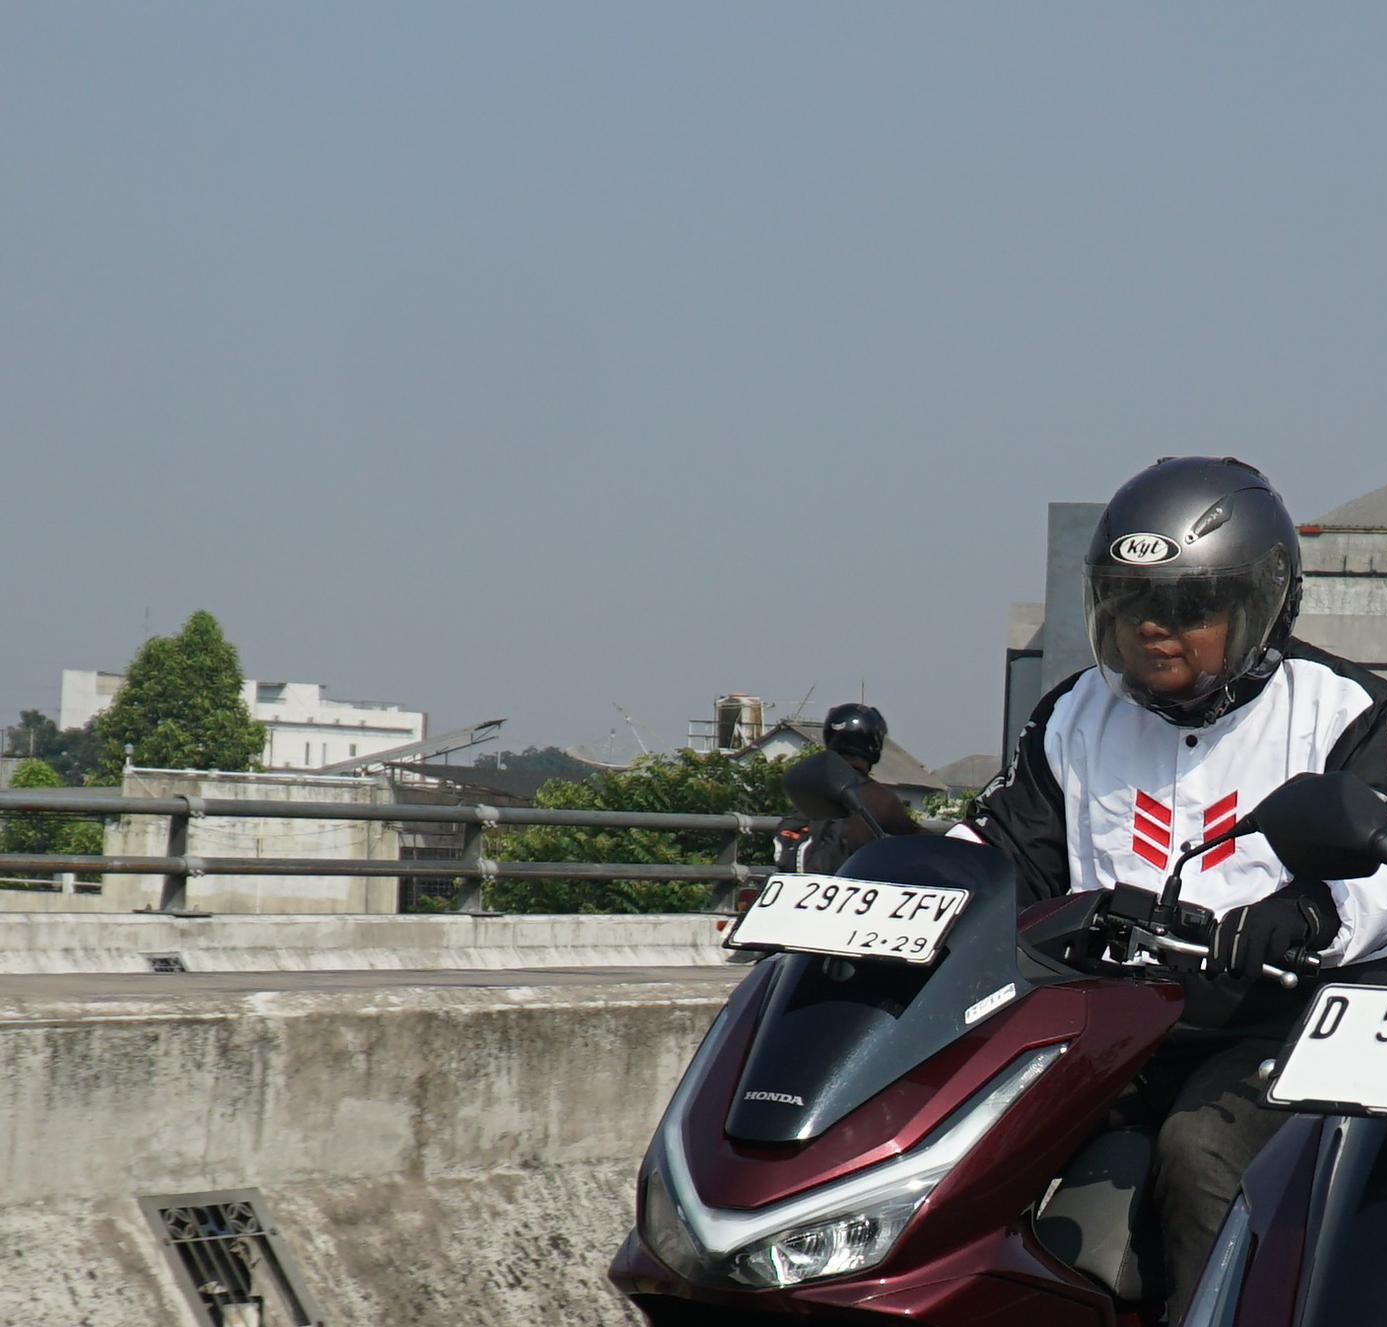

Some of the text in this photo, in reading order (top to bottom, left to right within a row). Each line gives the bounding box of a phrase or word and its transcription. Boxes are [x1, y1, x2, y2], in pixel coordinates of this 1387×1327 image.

[758, 880, 957, 923] D 2979 ZFV
[1308, 995, 1350, 1040] D
[743, 1090, 805, 1107] HONDA
